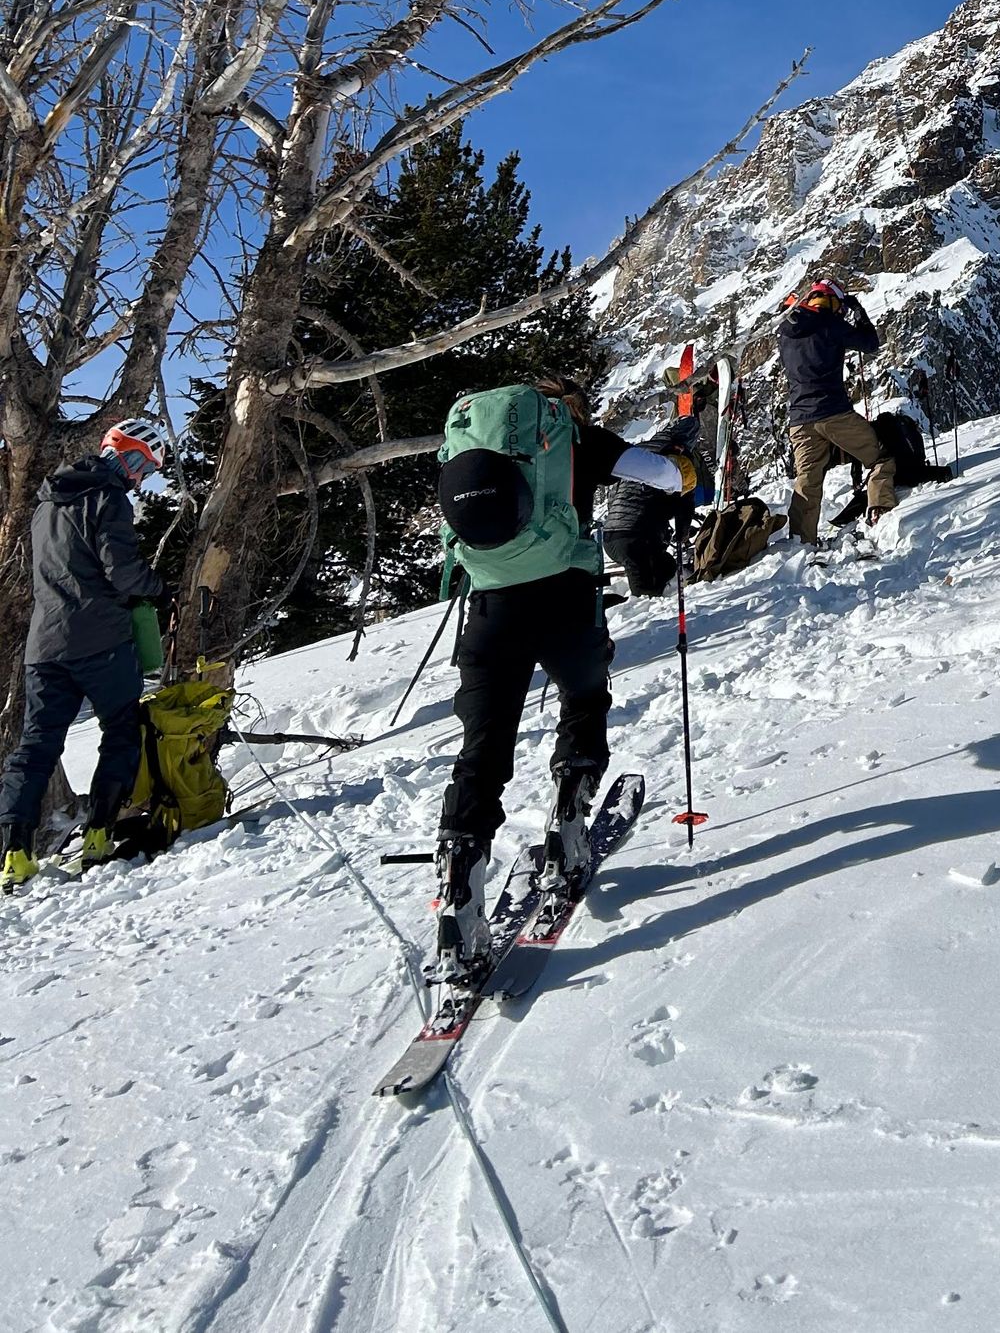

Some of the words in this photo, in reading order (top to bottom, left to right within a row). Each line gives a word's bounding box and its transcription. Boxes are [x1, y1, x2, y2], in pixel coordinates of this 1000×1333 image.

[508, 402, 519, 455] TOVOX
[701, 450, 718, 475] RTON
[453, 488, 497, 502] ORTOVOX
